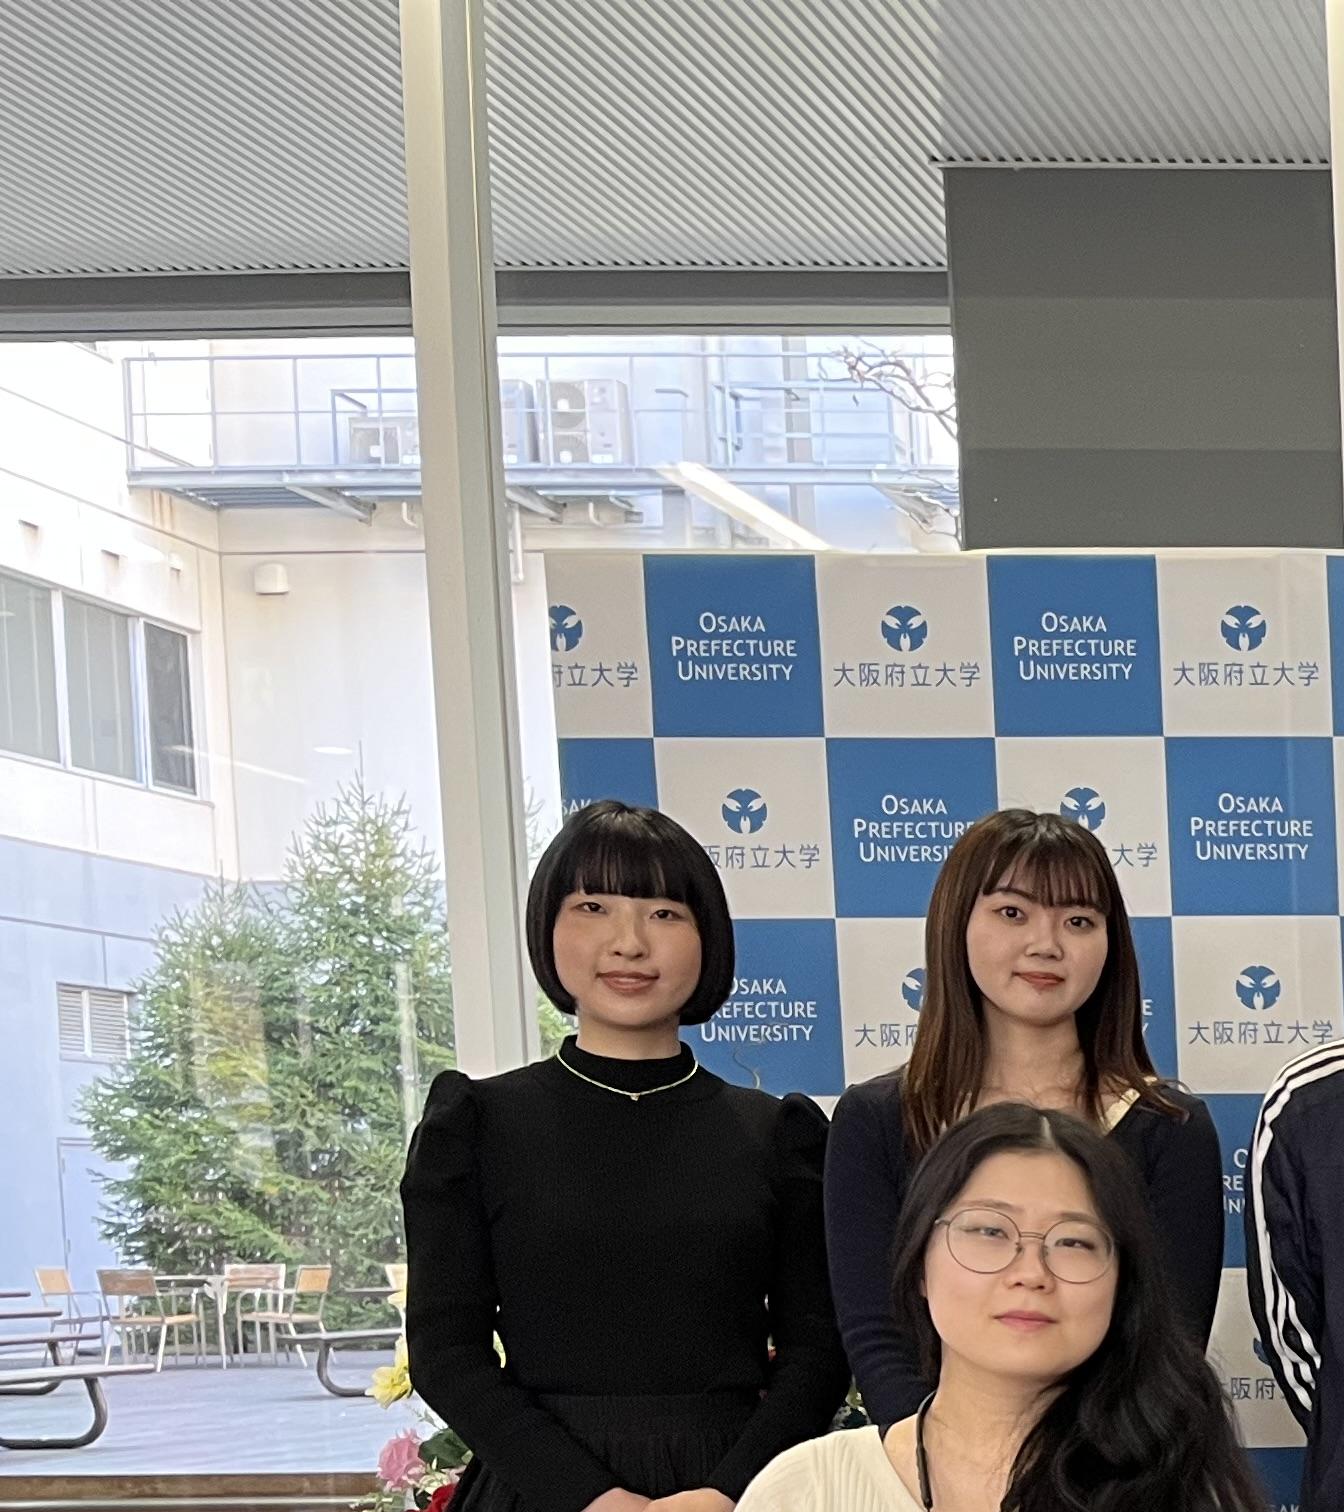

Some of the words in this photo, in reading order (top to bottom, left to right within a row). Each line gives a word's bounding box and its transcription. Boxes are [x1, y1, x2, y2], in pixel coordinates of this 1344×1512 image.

[700, 612, 765, 632] OSAKA
[1042, 612, 1106, 632] OSAKA
[672, 636, 797, 656] PREFECTURE
[1014, 637, 1136, 656] PREFECTURE
[678, 661, 792, 680] UNIVERSITY
[833, 662, 980, 687] 大阪府立大学
[1020, 661, 1132, 680] UNIVERSITY
[1173, 662, 1319, 686] 大阪府立大学
[882, 795, 947, 814] OSAKA
[1219, 793, 1283, 813] OSAKA
[1191, 817, 1313, 836] PREFECTURE
[703, 844, 820, 869] 府立大学
[859, 842, 953, 862] UNIVERSI
[1196, 841, 1308, 860] UNIVERSITY
[713, 1001, 818, 1018] EFECTURE
[701, 1023, 813, 1043] UNIVERSITY
[1188, 1020, 1333, 1044] 大阪府立大学
